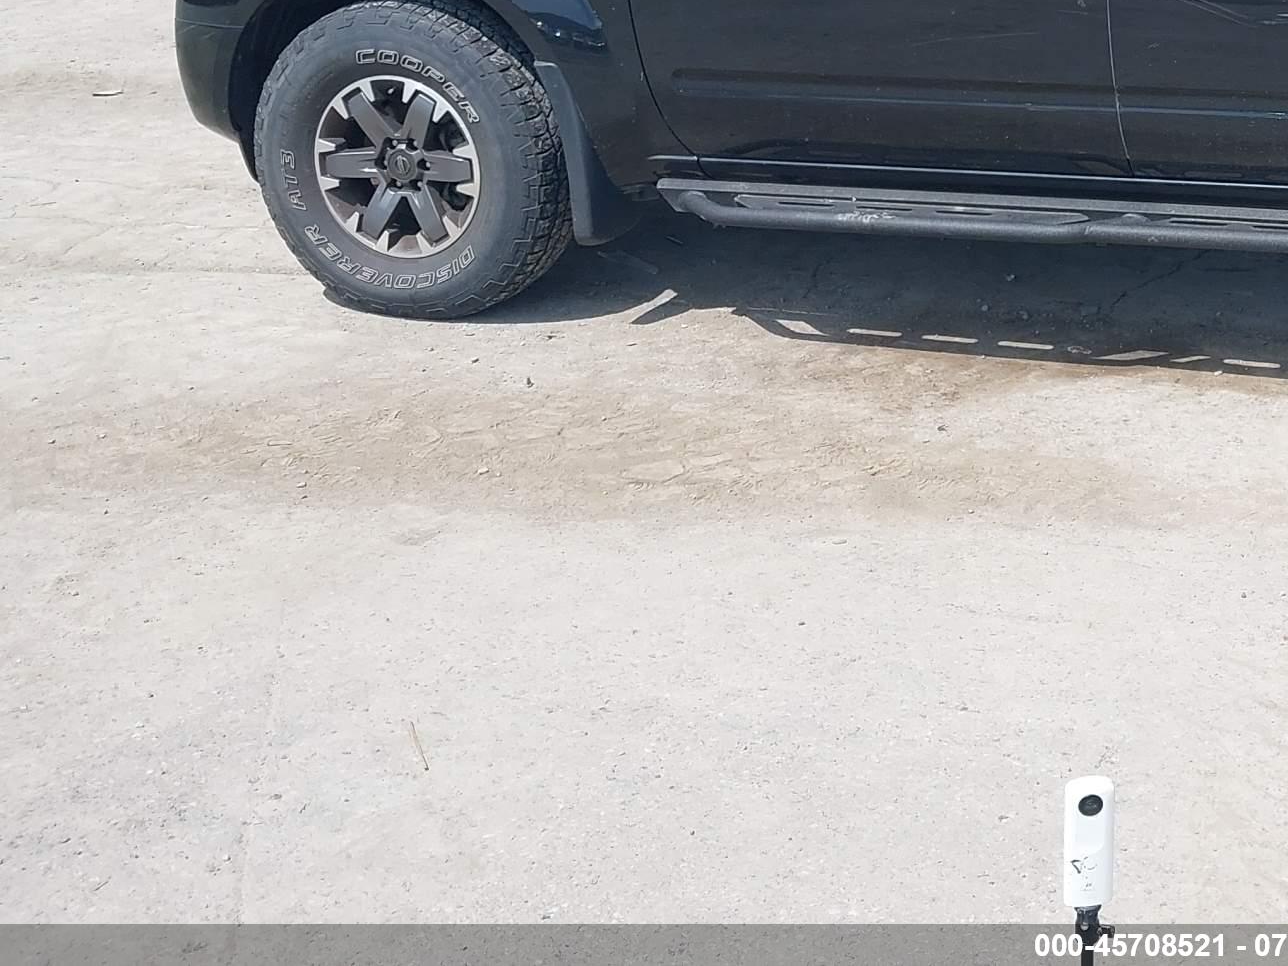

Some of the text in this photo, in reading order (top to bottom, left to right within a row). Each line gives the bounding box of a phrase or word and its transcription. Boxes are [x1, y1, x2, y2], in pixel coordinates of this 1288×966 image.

[355, 48, 480, 124] COOPER
[280, 148, 476, 290] DISCOVERER AT3
